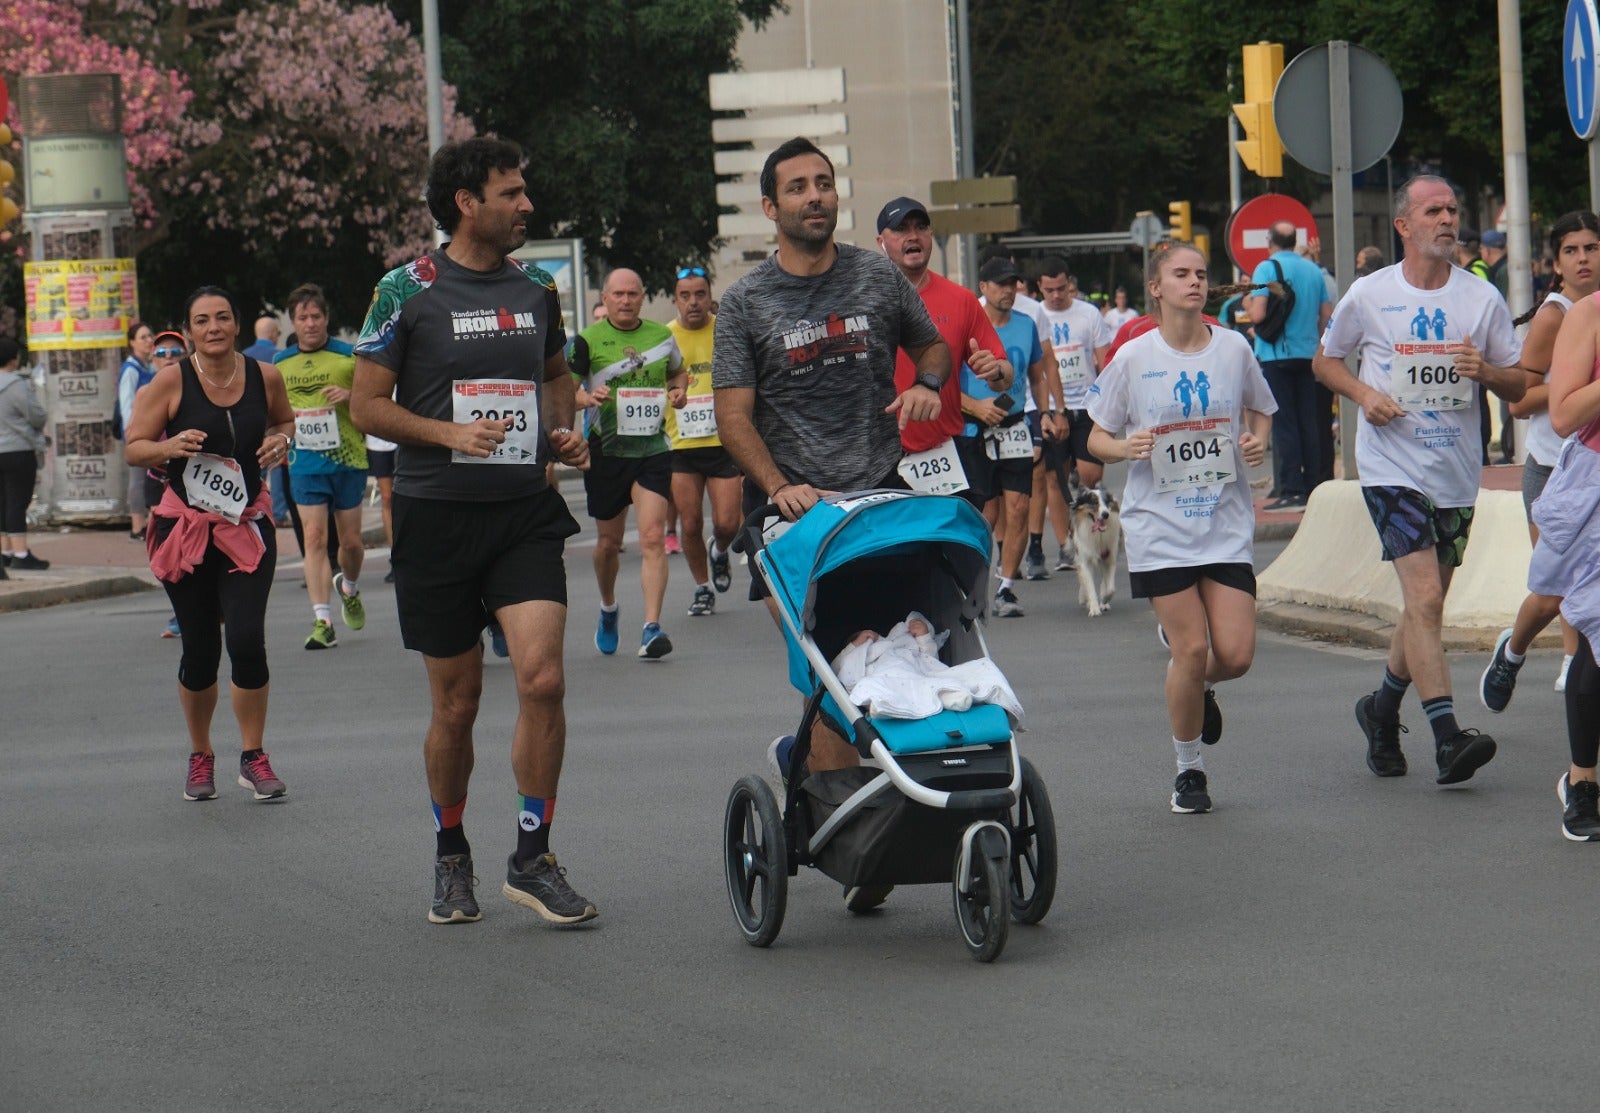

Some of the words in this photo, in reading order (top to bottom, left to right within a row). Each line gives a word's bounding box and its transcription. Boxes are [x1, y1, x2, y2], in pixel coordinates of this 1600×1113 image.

[451, 310, 480, 318] Standard
[452, 307, 536, 333] IRONMAN
[501, 329, 537, 337] AFRICA
[782, 311, 870, 350] IRONMAN
[1395, 344, 1414, 355] 42
[1407, 365, 1460, 385] 1606
[62, 380, 94, 392] IZAL
[455, 383, 478, 396] 42
[625, 404, 660, 418] 9189
[683, 409, 714, 423] 3657
[299, 422, 329, 435] 6061
[997, 429, 1027, 442] 3129
[1165, 437, 1222, 464] 1604
[70, 463, 101, 475] IZAL
[909, 456, 951, 480] 1283
[192, 463, 245, 503] 11890
[1176, 492, 1221, 505] Fundació
